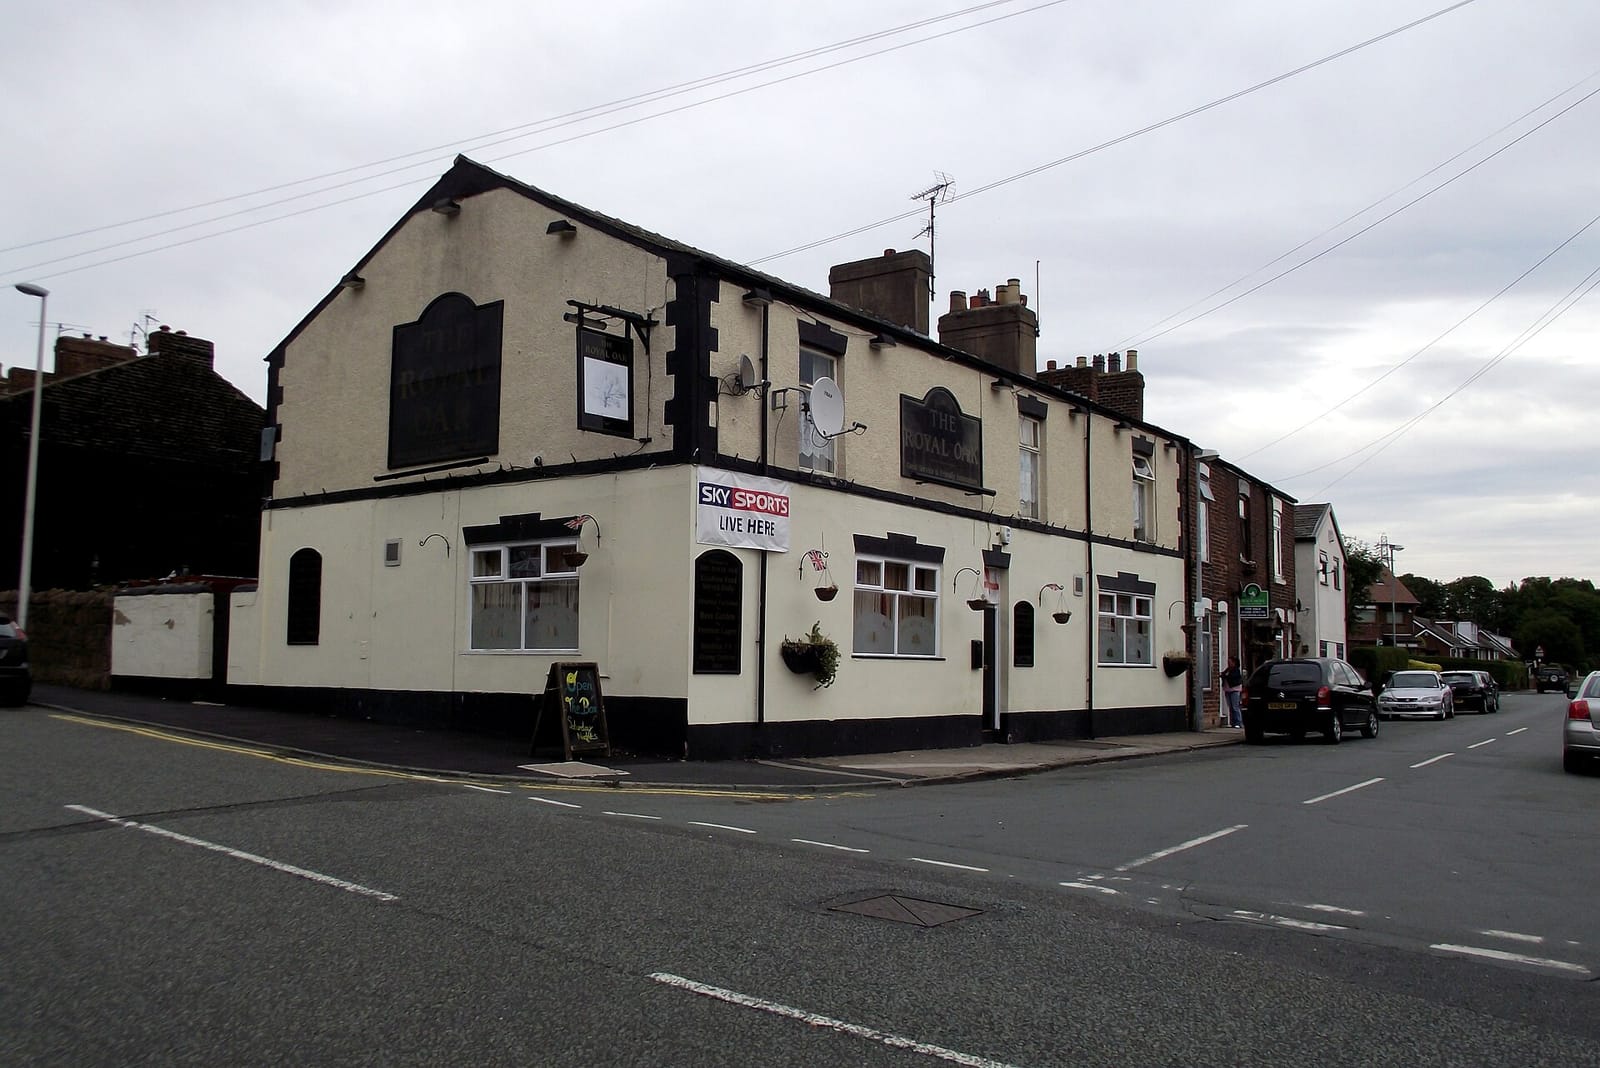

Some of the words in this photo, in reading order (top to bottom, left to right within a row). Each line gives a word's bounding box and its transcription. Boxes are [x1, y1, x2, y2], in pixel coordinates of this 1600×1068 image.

[930, 408, 956, 433] THE
[904, 430, 949, 457] ROYAL
[954, 442, 979, 466] OAK
[701, 485, 731, 505] SKY
[734, 491, 788, 514] SPORTS
[719, 514, 743, 532] LIVE
[747, 518, 775, 537] HERE
